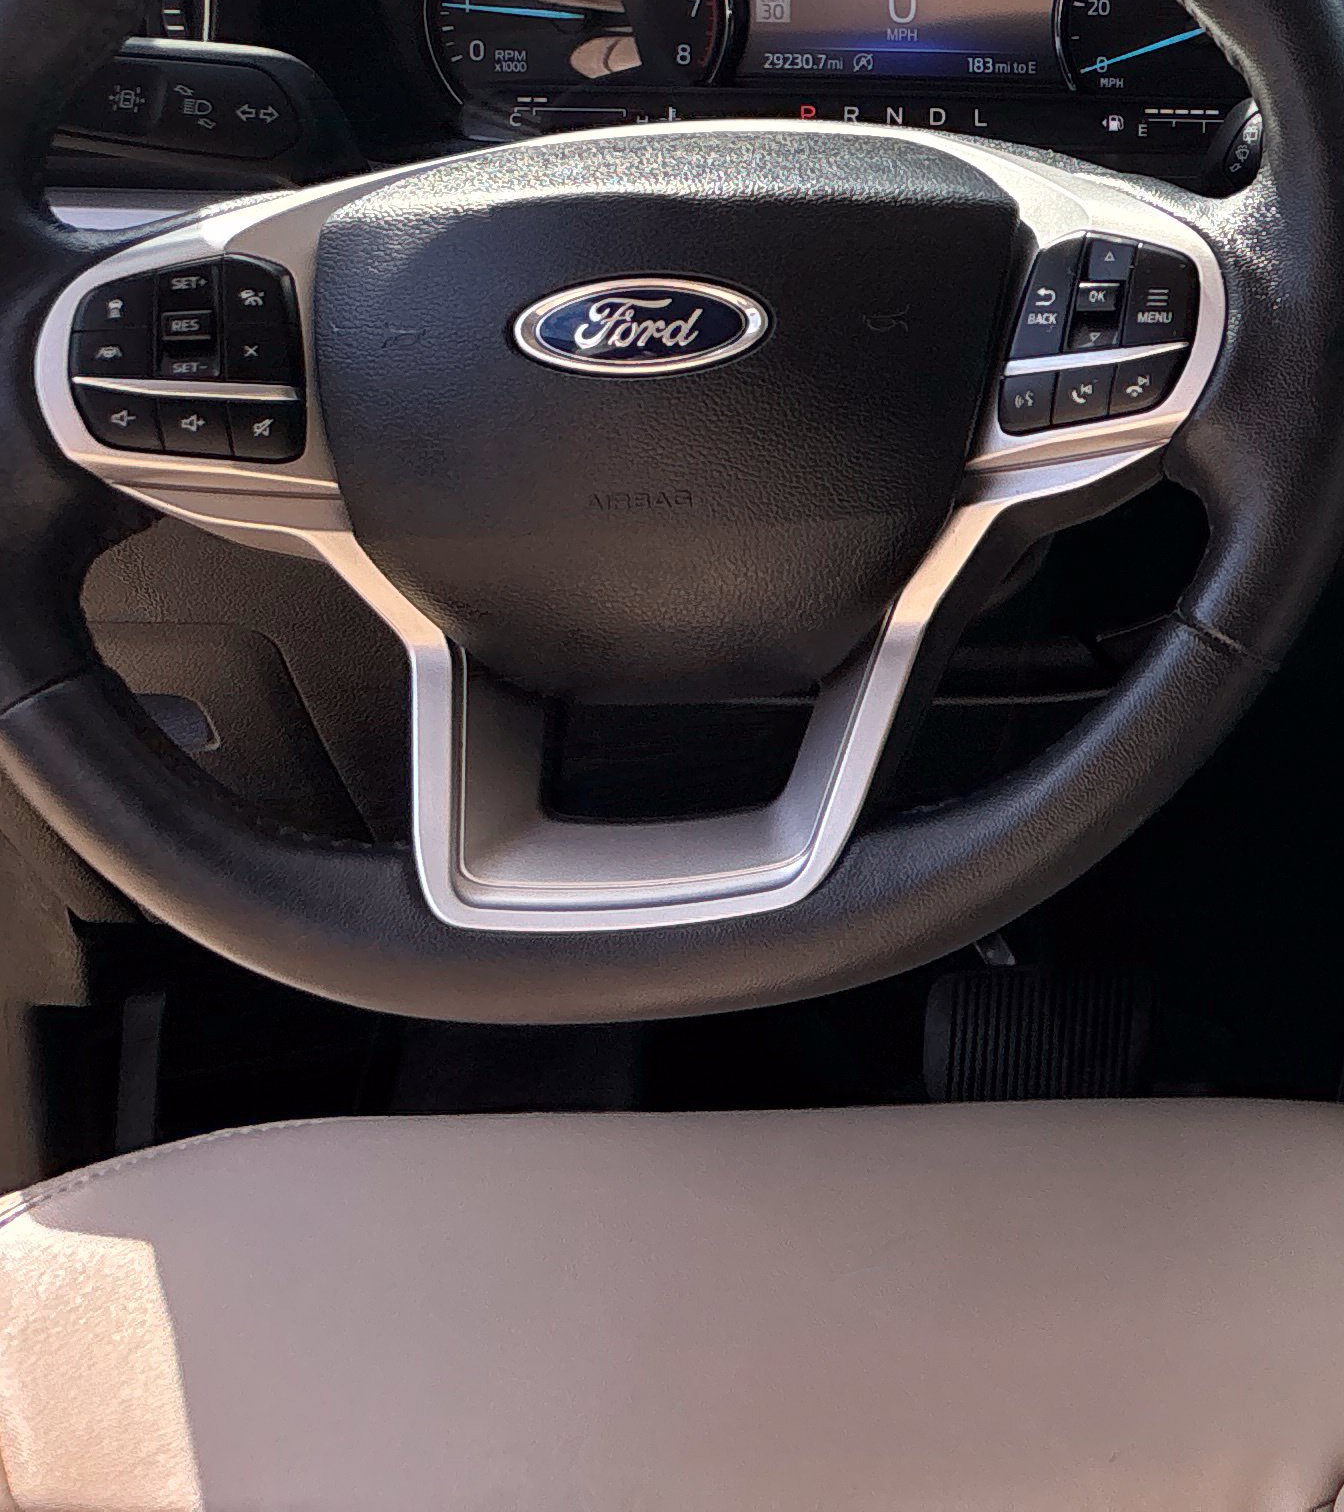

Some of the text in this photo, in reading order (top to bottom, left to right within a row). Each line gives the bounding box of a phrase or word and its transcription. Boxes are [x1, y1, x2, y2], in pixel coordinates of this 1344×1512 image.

[762, 4, 784, 20] 30
[1087, 0, 1110, 16] 20
[887, 28, 918, 41] MPH
[469, 40, 485, 61] 0
[495, 50, 526, 61] RPM
[676, 45, 691, 66] 8
[494, 61, 527, 73] x1000
[967, 57, 1037, 75] 183 mi to E
[1096, 56, 1108, 73] 0
[1100, 78, 1124, 89] MPH
[509, 113, 521, 127] C
[801, 104, 987, 127] P R N D L
[1138, 124, 1147, 137] E
[1089, 290, 1106, 303] OK
[574, 297, 704, 350] Ford
[1027, 313, 1058, 325] BACK
[1137, 312, 1173, 324] MENU
[171, 319, 199, 332] RES
[588, 489, 693, 510] AIRBAG
